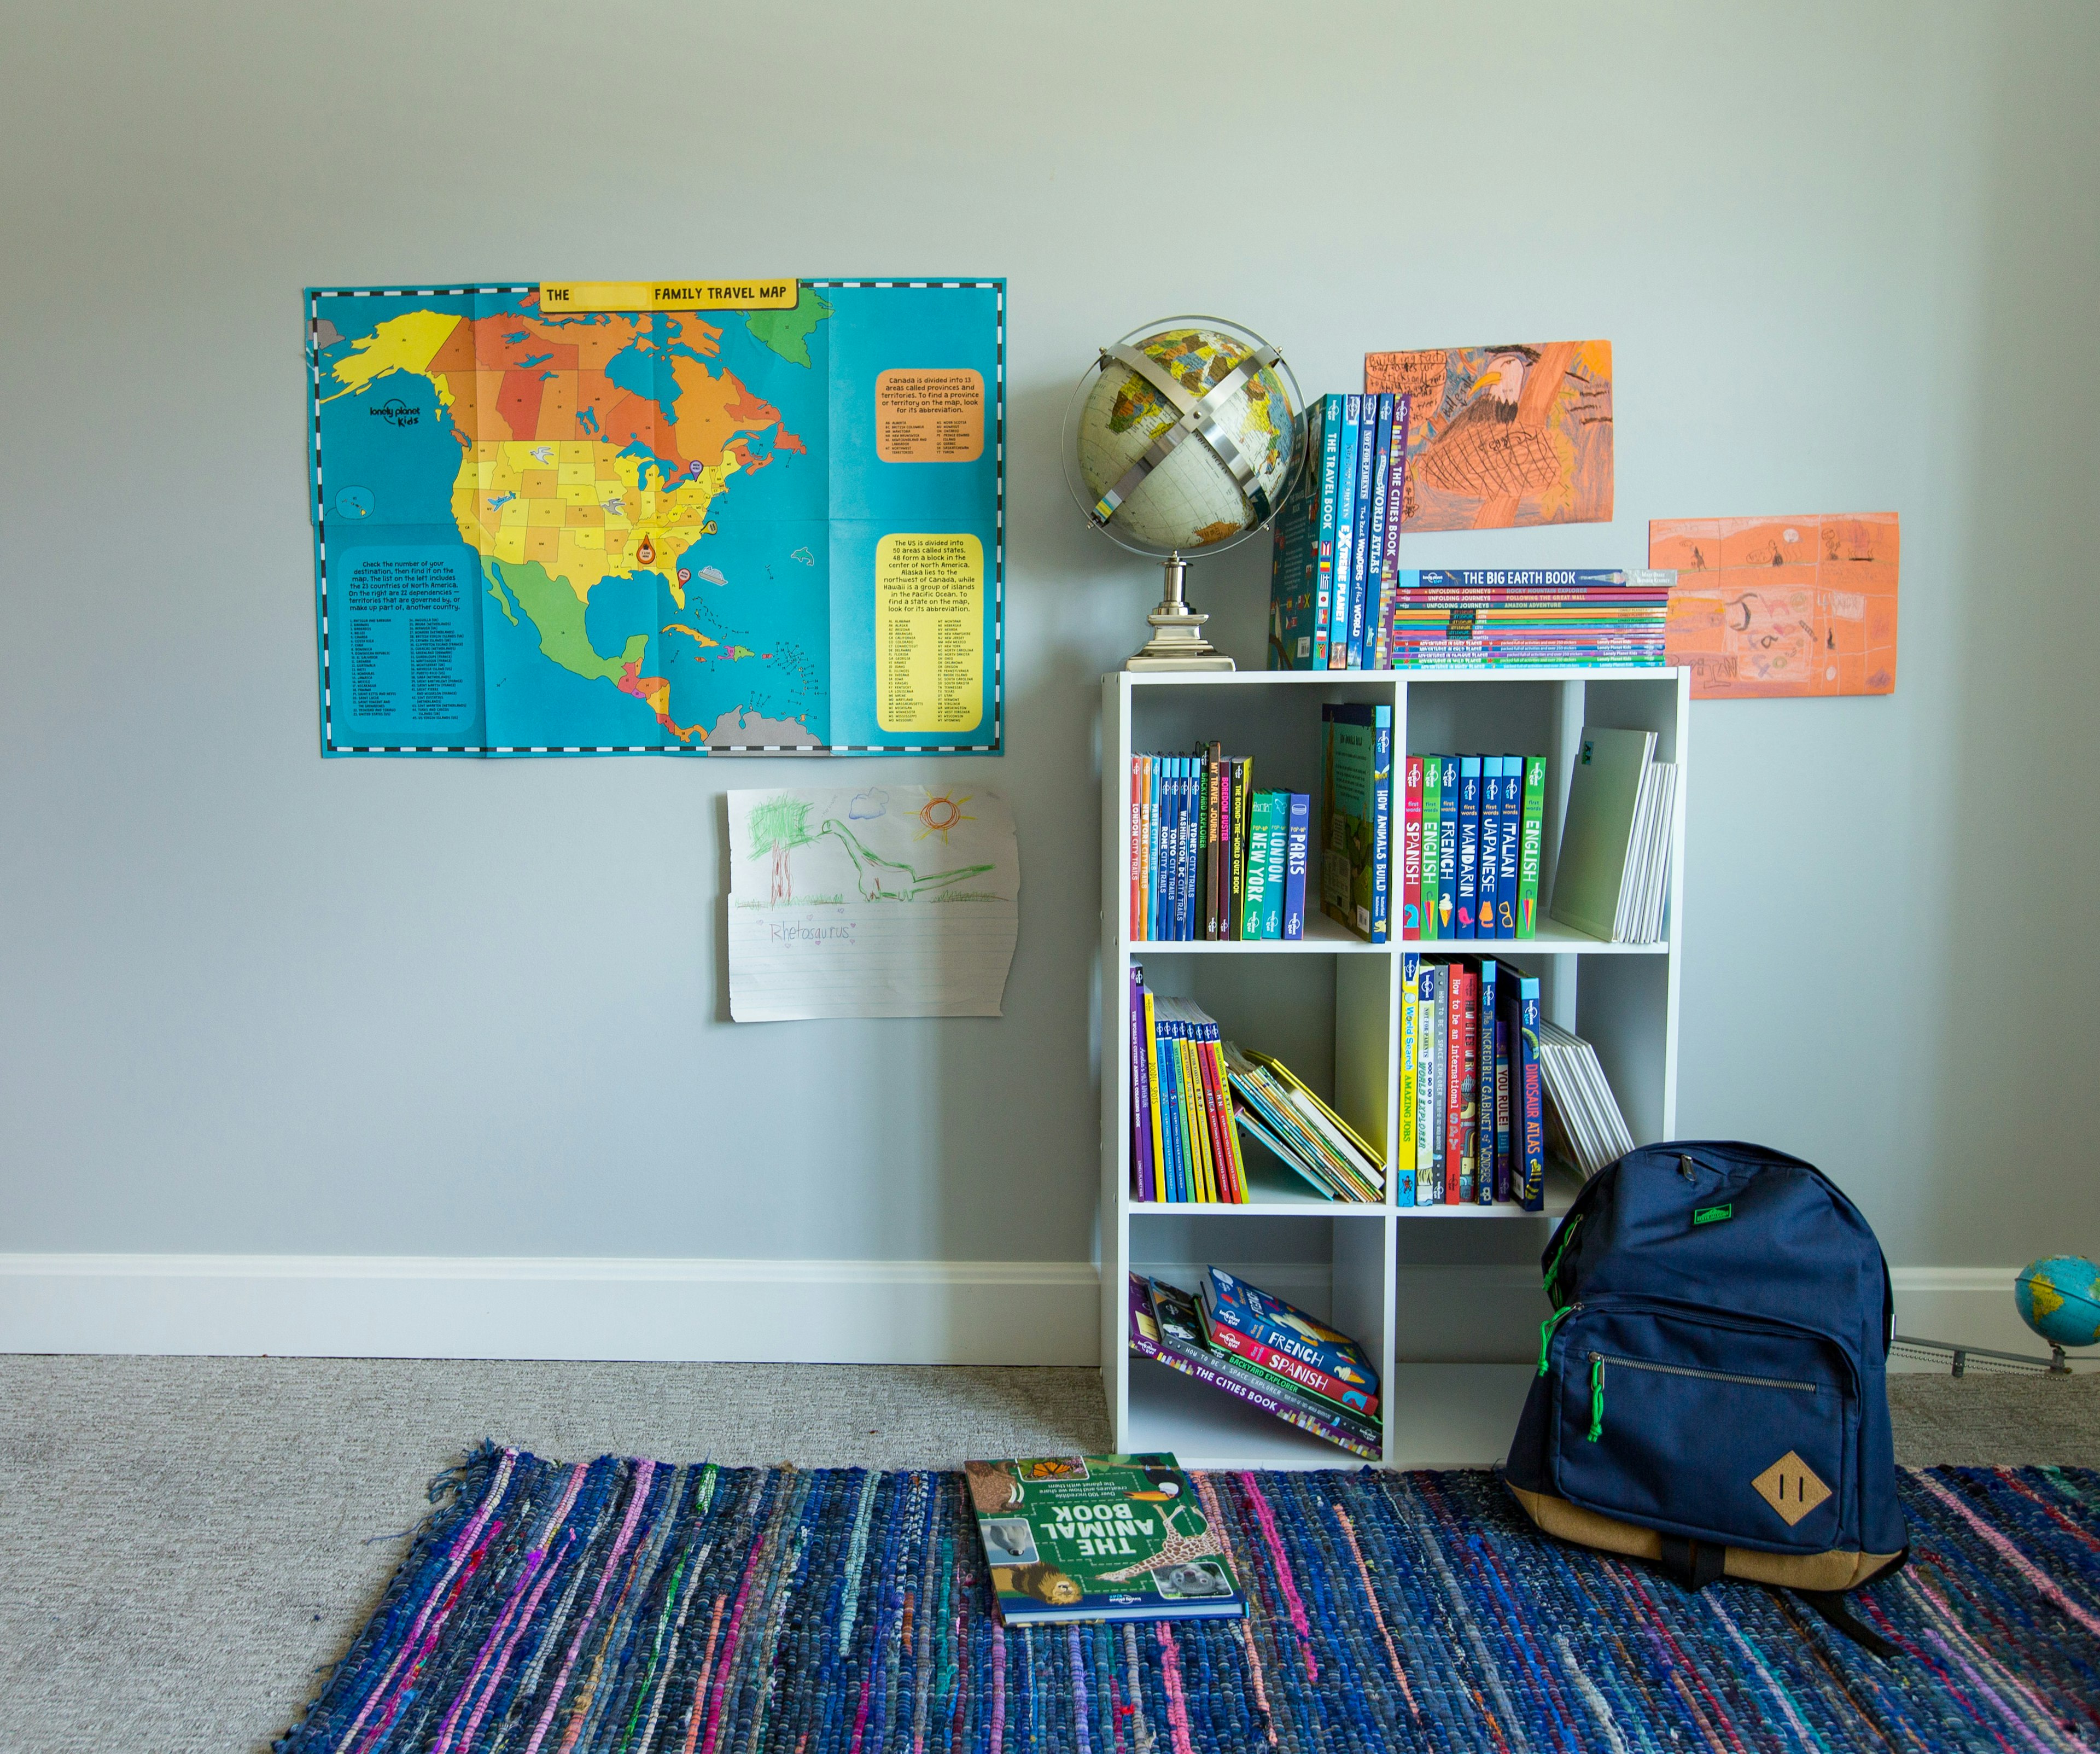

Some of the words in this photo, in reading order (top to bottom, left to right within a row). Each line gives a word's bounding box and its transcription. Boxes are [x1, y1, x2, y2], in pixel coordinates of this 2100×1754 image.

[547, 289, 569, 301] THE
[655, 288, 702, 300] FAMILY
[707, 287, 755, 299] TRAVEL
[760, 286, 786, 298] MAP
[370, 407, 393, 418] lonely
[395, 406, 420, 417] planet
[1327, 433, 1337, 452] THE
[1325, 456, 1335, 495] TRAVEL
[1392, 467, 1402, 486] THE
[1323, 498, 1333, 529] BOOK
[1373, 485, 1385, 532] WORLD
[1390, 490, 1400, 522] CITIES
[1370, 534, 1381, 573] ATLAS
[1387, 525, 1397, 556] BOOK
[1356, 538, 1365, 581] WONDERS
[1463, 572, 1484, 584] THE
[1487, 572, 1504, 584] BIG
[1508, 572, 1542, 584] EARTH
[1545, 572, 1575, 584] BOOK
[1336, 584, 1346, 622] PLANET
[1353, 604, 1361, 637] WORLD
[1211, 762, 1218, 774] MY
[1377, 790, 1388, 811] HOW
[1178, 810, 1187, 865] WASHINGTON,
[1209, 808, 1217, 843] JOURNAL
[1376, 815, 1387, 860] ANIMALS
[1250, 832, 1267, 863] NEW
[1268, 832, 1287, 883] LONDON
[1290, 834, 1306, 875] PARIS
[1406, 822, 1420, 884] SPANISH
[1423, 822, 1437, 883] ENGLISH
[1440, 821, 1455, 879] FRENCH
[1460, 824, 1476, 897] MANDARIN
[1481, 819, 1497, 893] JAPANESE
[1501, 823, 1516, 877] ITALIAN
[1522, 820, 1539, 882] ENGLISH
[1178, 867, 1185, 877] DC
[1247, 867, 1265, 902] YORK
[1376, 864, 1386, 891] BUILD
[1452, 979, 1461, 995] How
[1452, 999, 1461, 1010] to
[1405, 1006, 1414, 1036] World
[1451, 1029, 1459, 1039] an
[1452, 1014, 1461, 1025] be
[1404, 1038, 1414, 1071] Search
[1482, 1028, 1492, 1082] INCREDIBLE
[1450, 1044, 1460, 1109] international
[1498, 1070, 1508, 1092] YOU
[1526, 1064, 1539, 1118] DINOSAUR
[1404, 1075, 1412, 1118] AMAZING
[1498, 1095, 1508, 1126] RULE!
[1527, 1122, 1540, 1154] ATLAS
[1268, 1331, 1325, 1367] FRENCH
[1185, 1347, 1198, 1357] HOW
[1229, 1368, 1248, 1381] SPACE
[1251, 1378, 1281, 1396] EXPLORER
[1195, 1366, 1216, 1382] THE
[1216, 1376, 1247, 1397] CITIES
[1247, 1391, 1278, 1411] BOOK
[1229, 1356, 1264, 1379] BACKYARD
[1265, 1372, 1298, 1392] EXPLORER
[1269, 1354, 1329, 1391] SPANISH
[1040, 1519, 1154, 1540] ANIMAL
[1051, 1504, 1134, 1522] BOOK
[1076, 1537, 1136, 1556] THE
